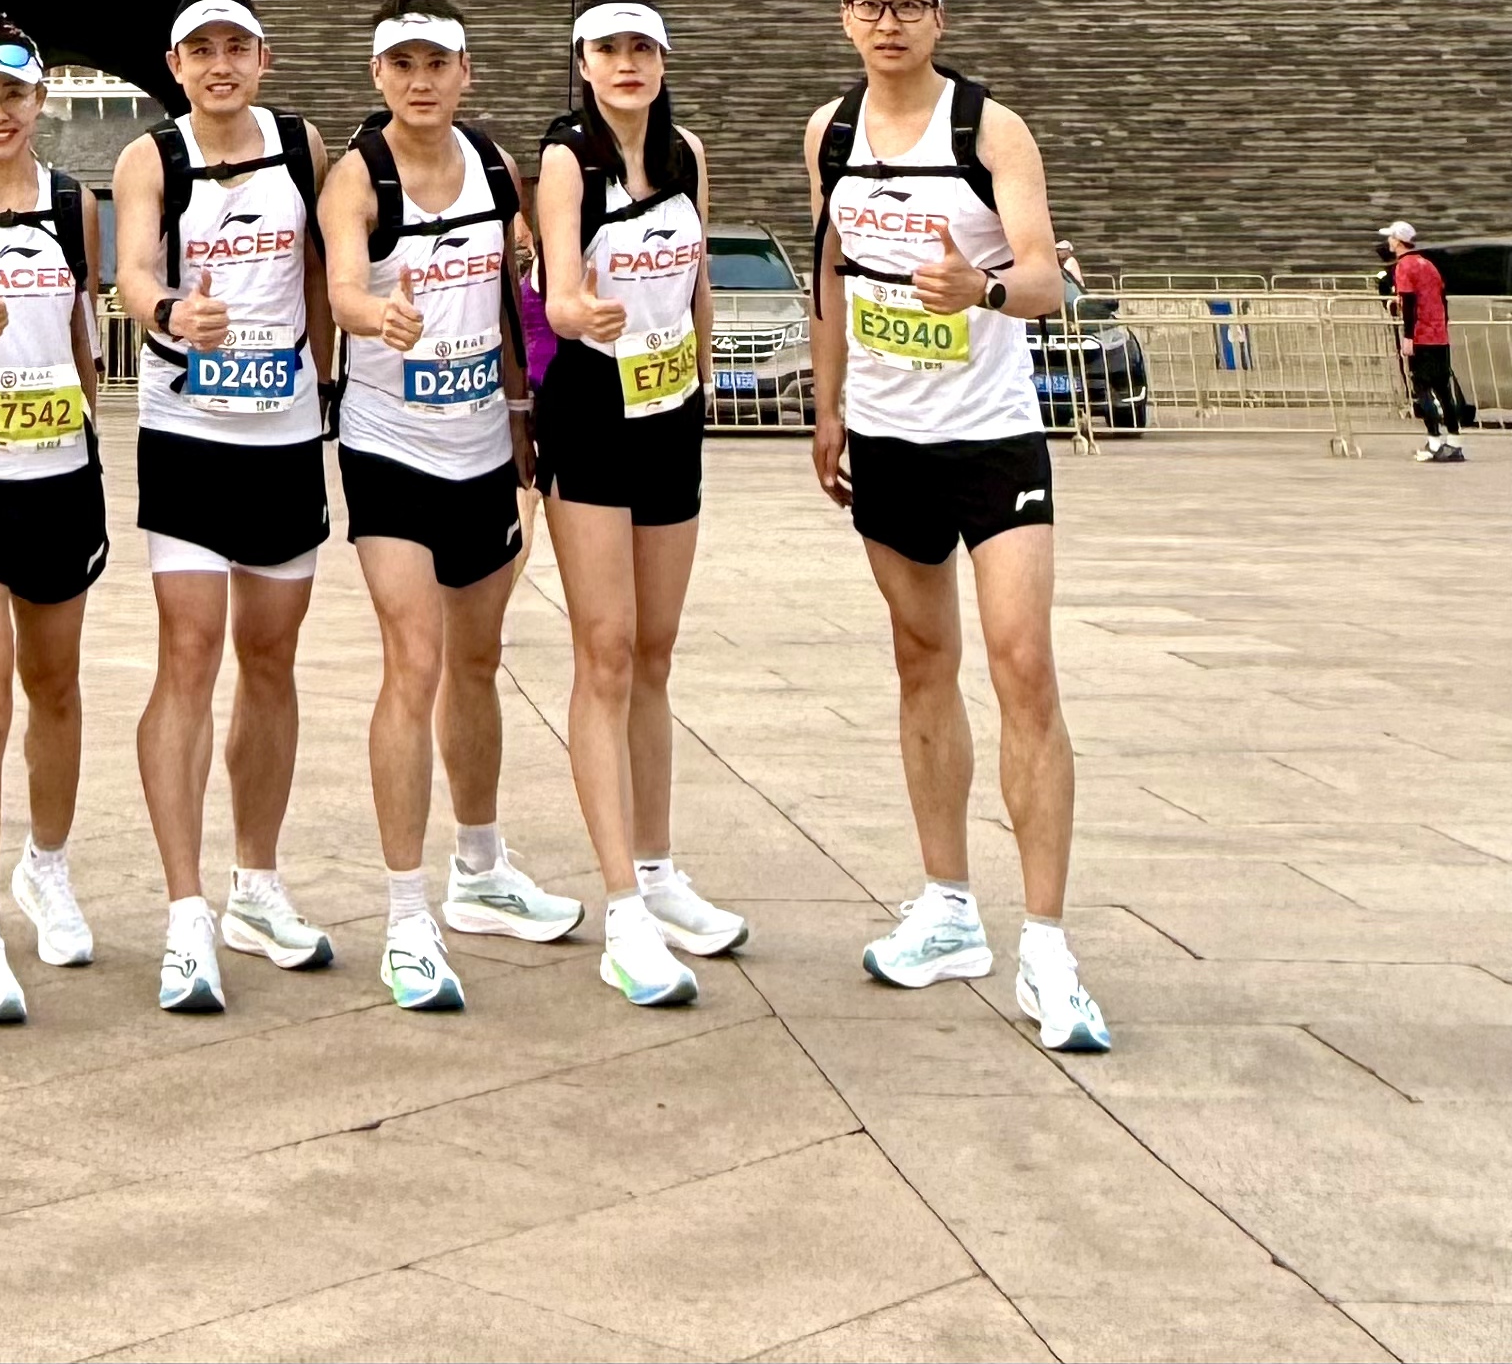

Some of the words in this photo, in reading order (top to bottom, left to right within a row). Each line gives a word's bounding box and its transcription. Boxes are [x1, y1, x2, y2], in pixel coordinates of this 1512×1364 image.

[838, 205, 951, 234] PACER
[185, 229, 296, 262] PACER
[409, 251, 501, 287] PACER
[859, 309, 953, 350] E2940
[199, 358, 288, 389] D2465
[414, 359, 499, 397] D2464
